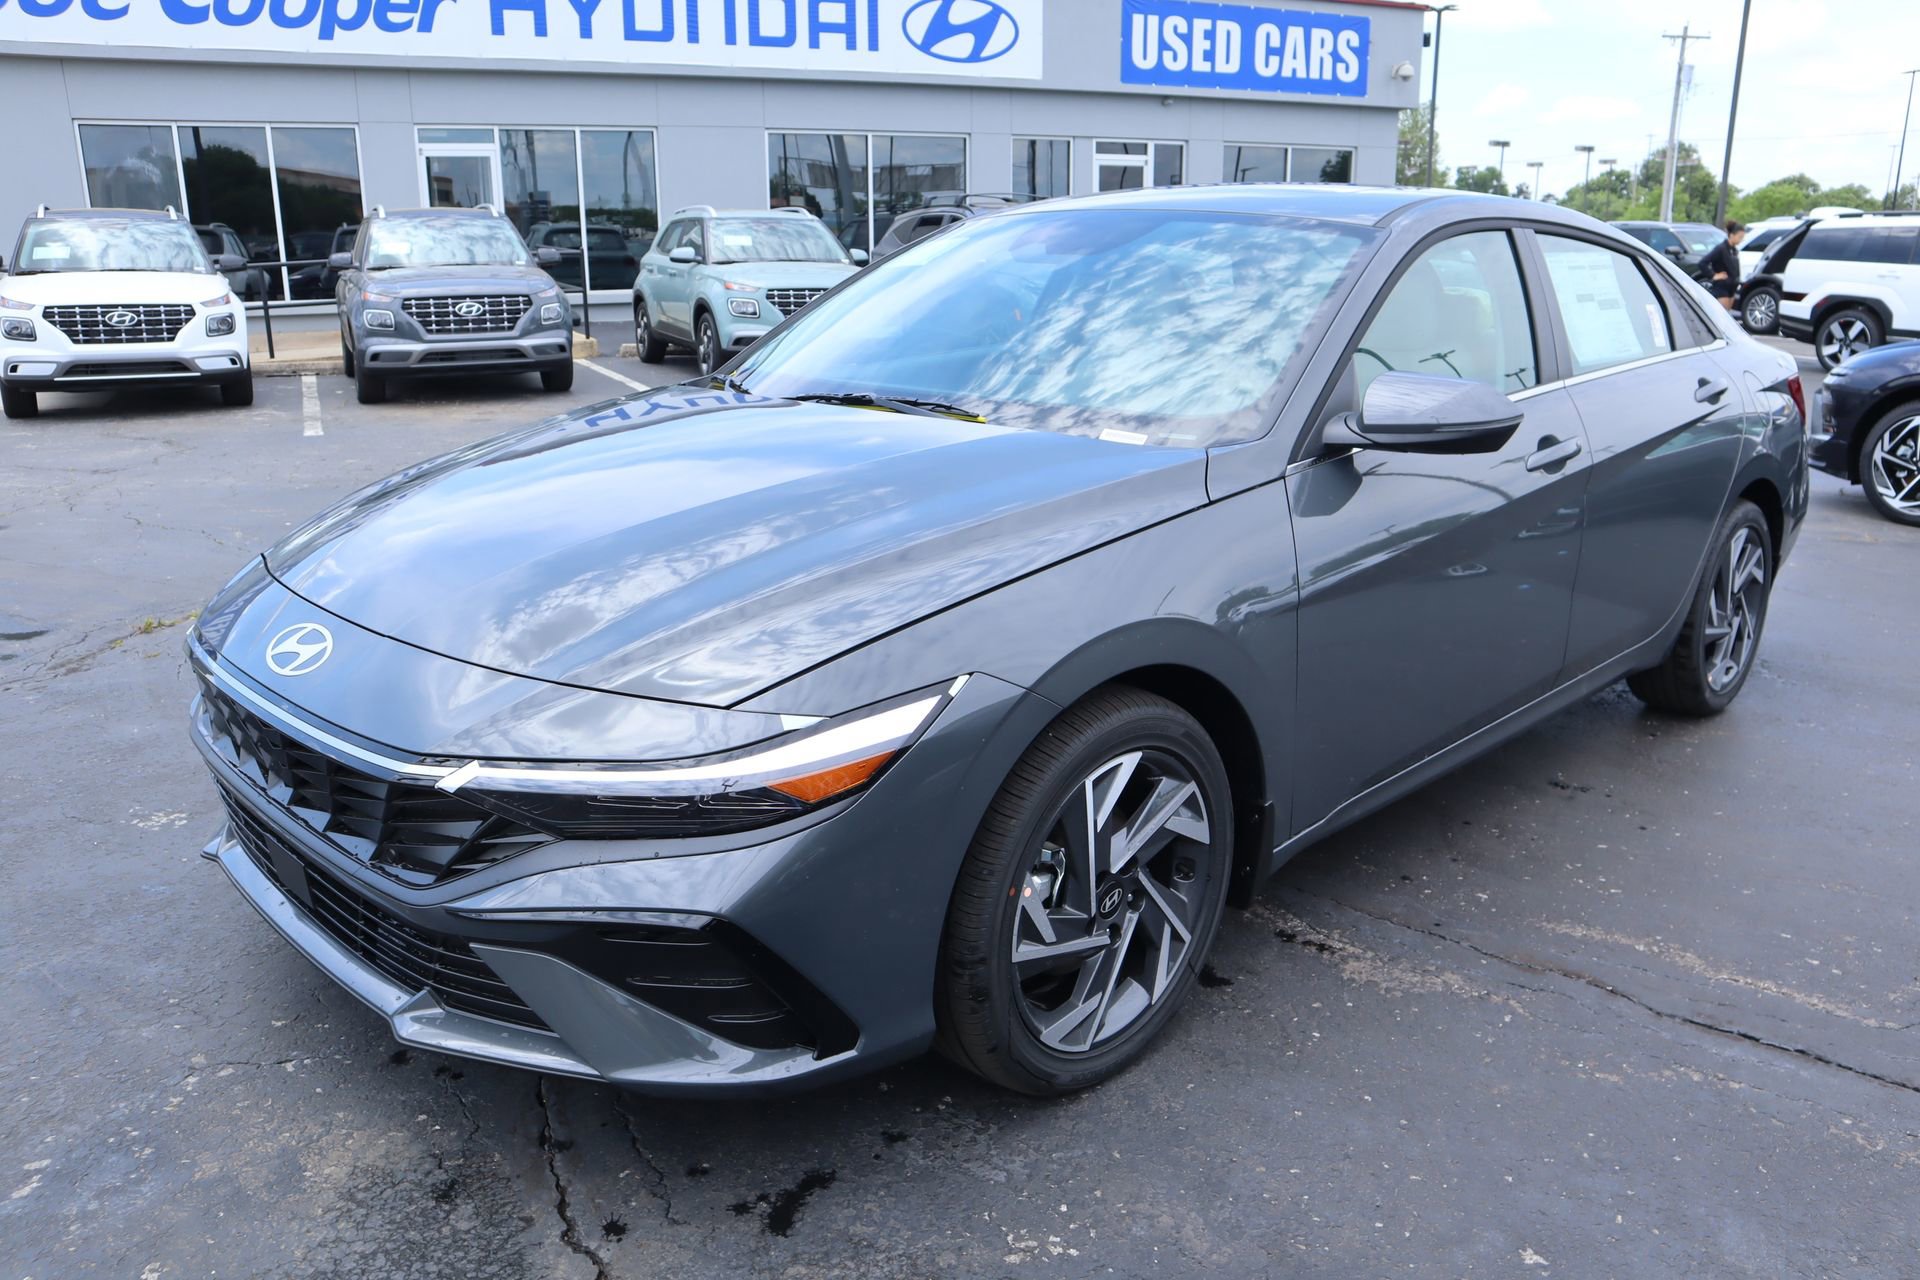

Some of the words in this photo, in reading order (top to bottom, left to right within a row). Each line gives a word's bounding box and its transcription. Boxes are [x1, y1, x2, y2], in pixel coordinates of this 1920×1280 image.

[489, 0, 880, 52] HYUNDAI
[1131, 13, 1242, 74] USED
[1254, 23, 1360, 83] CARS
